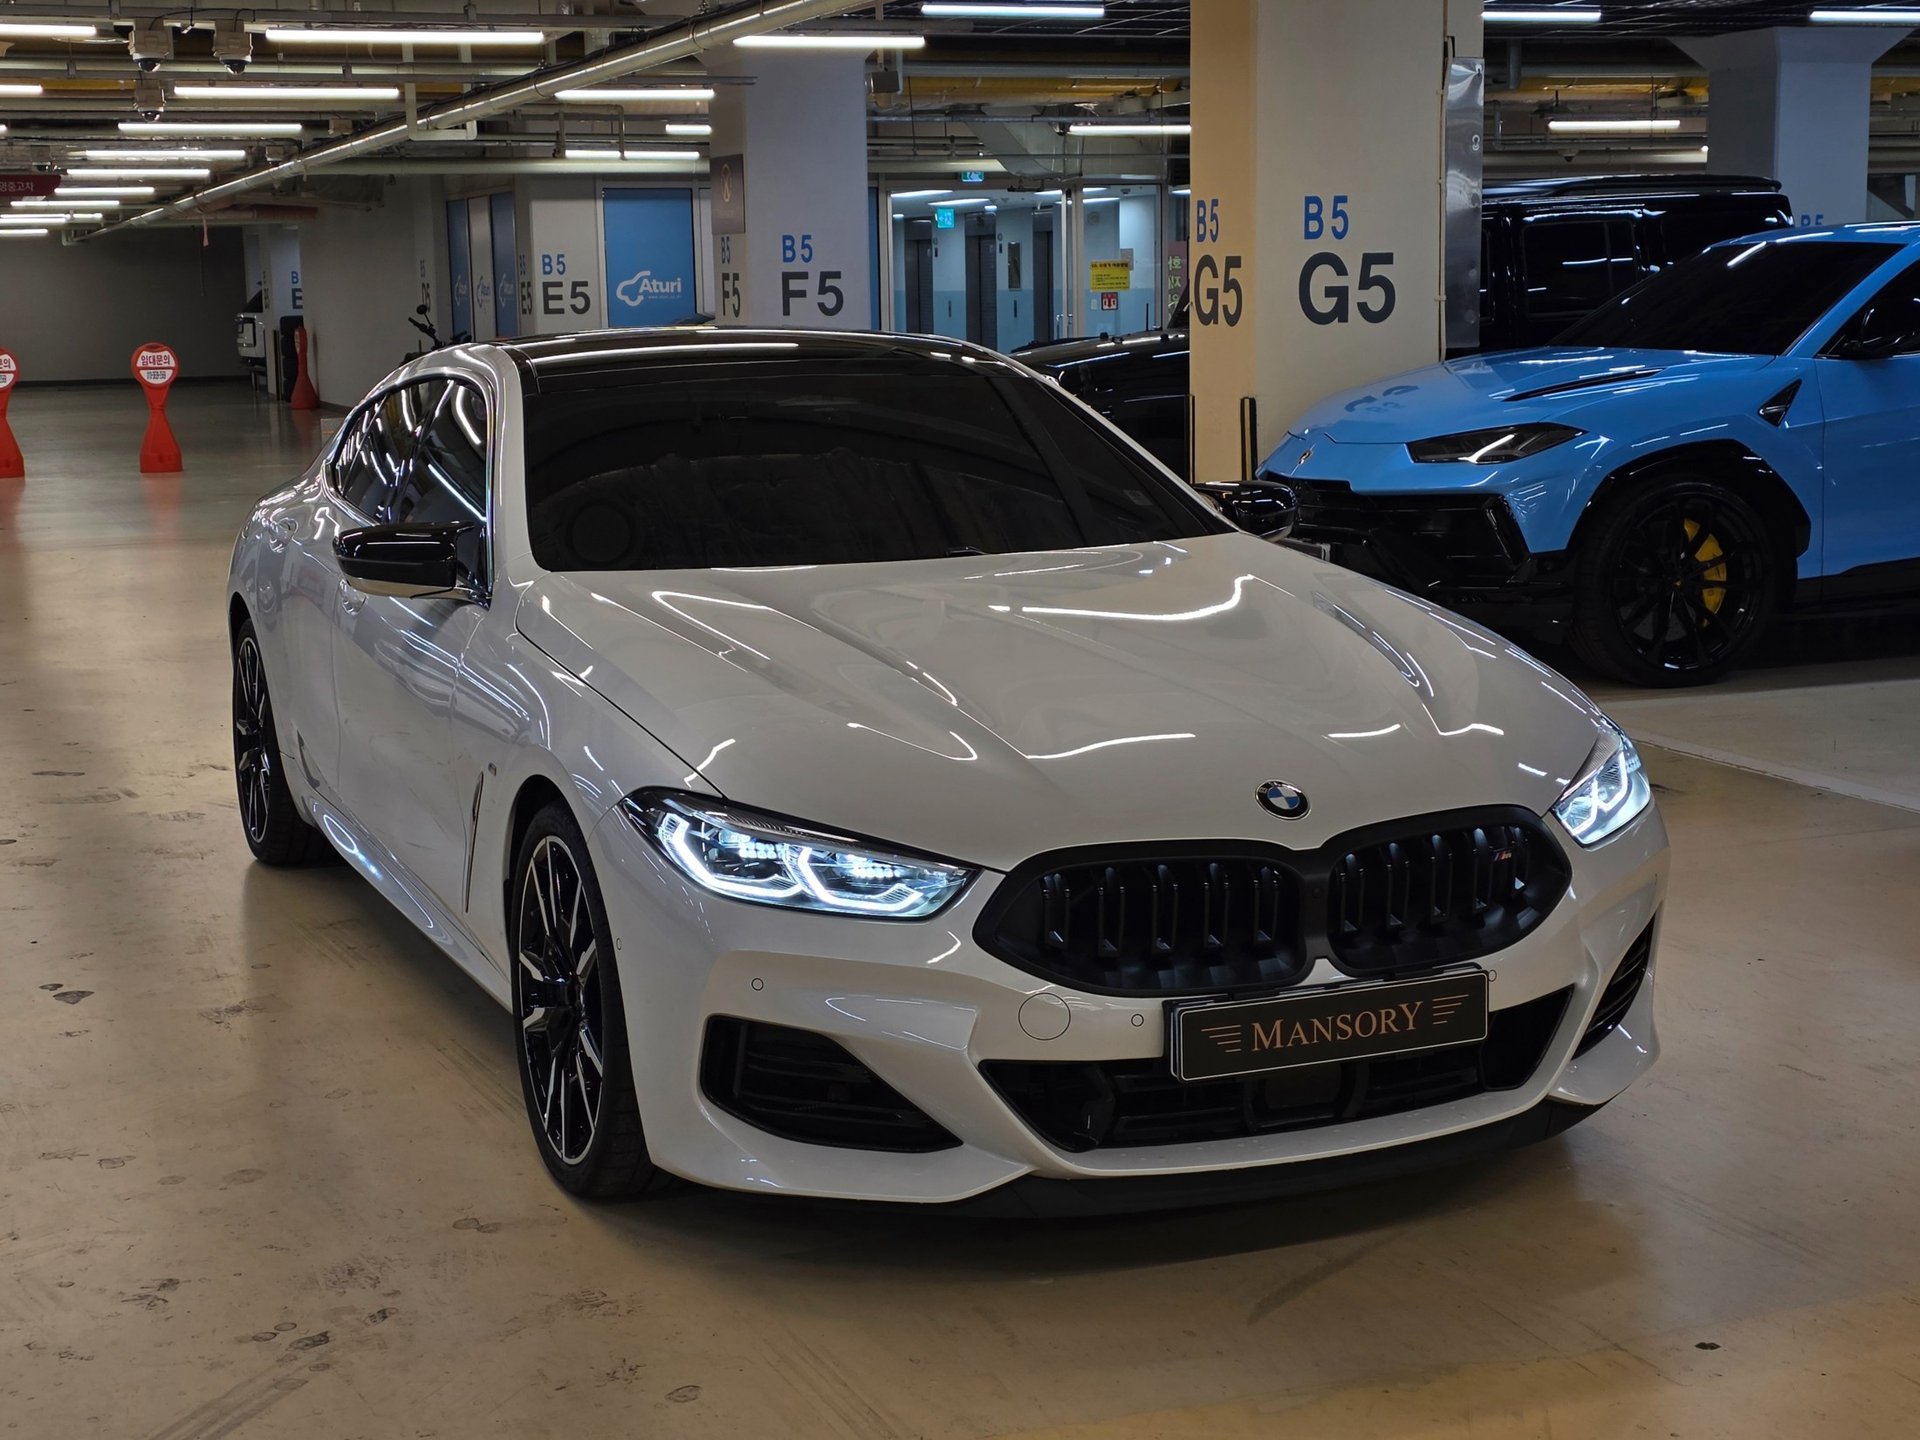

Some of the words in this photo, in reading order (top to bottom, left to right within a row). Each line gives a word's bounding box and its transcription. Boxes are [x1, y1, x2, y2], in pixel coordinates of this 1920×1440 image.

[1196, 198, 1219, 242] B5
[1304, 195, 1349, 240] B5
[542, 253, 566, 276] B5
[782, 234, 813, 263] B5
[542, 281, 591, 315] E5
[639, 276, 682, 294] Aturi
[721, 272, 741, 318] F5
[781, 271, 844, 317] F5
[1194, 254, 1243, 327] G5
[1298, 251, 1396, 326] G5
[141, 354, 171, 366] 임대문의
[1251, 1001, 1424, 1051] MANSORY
